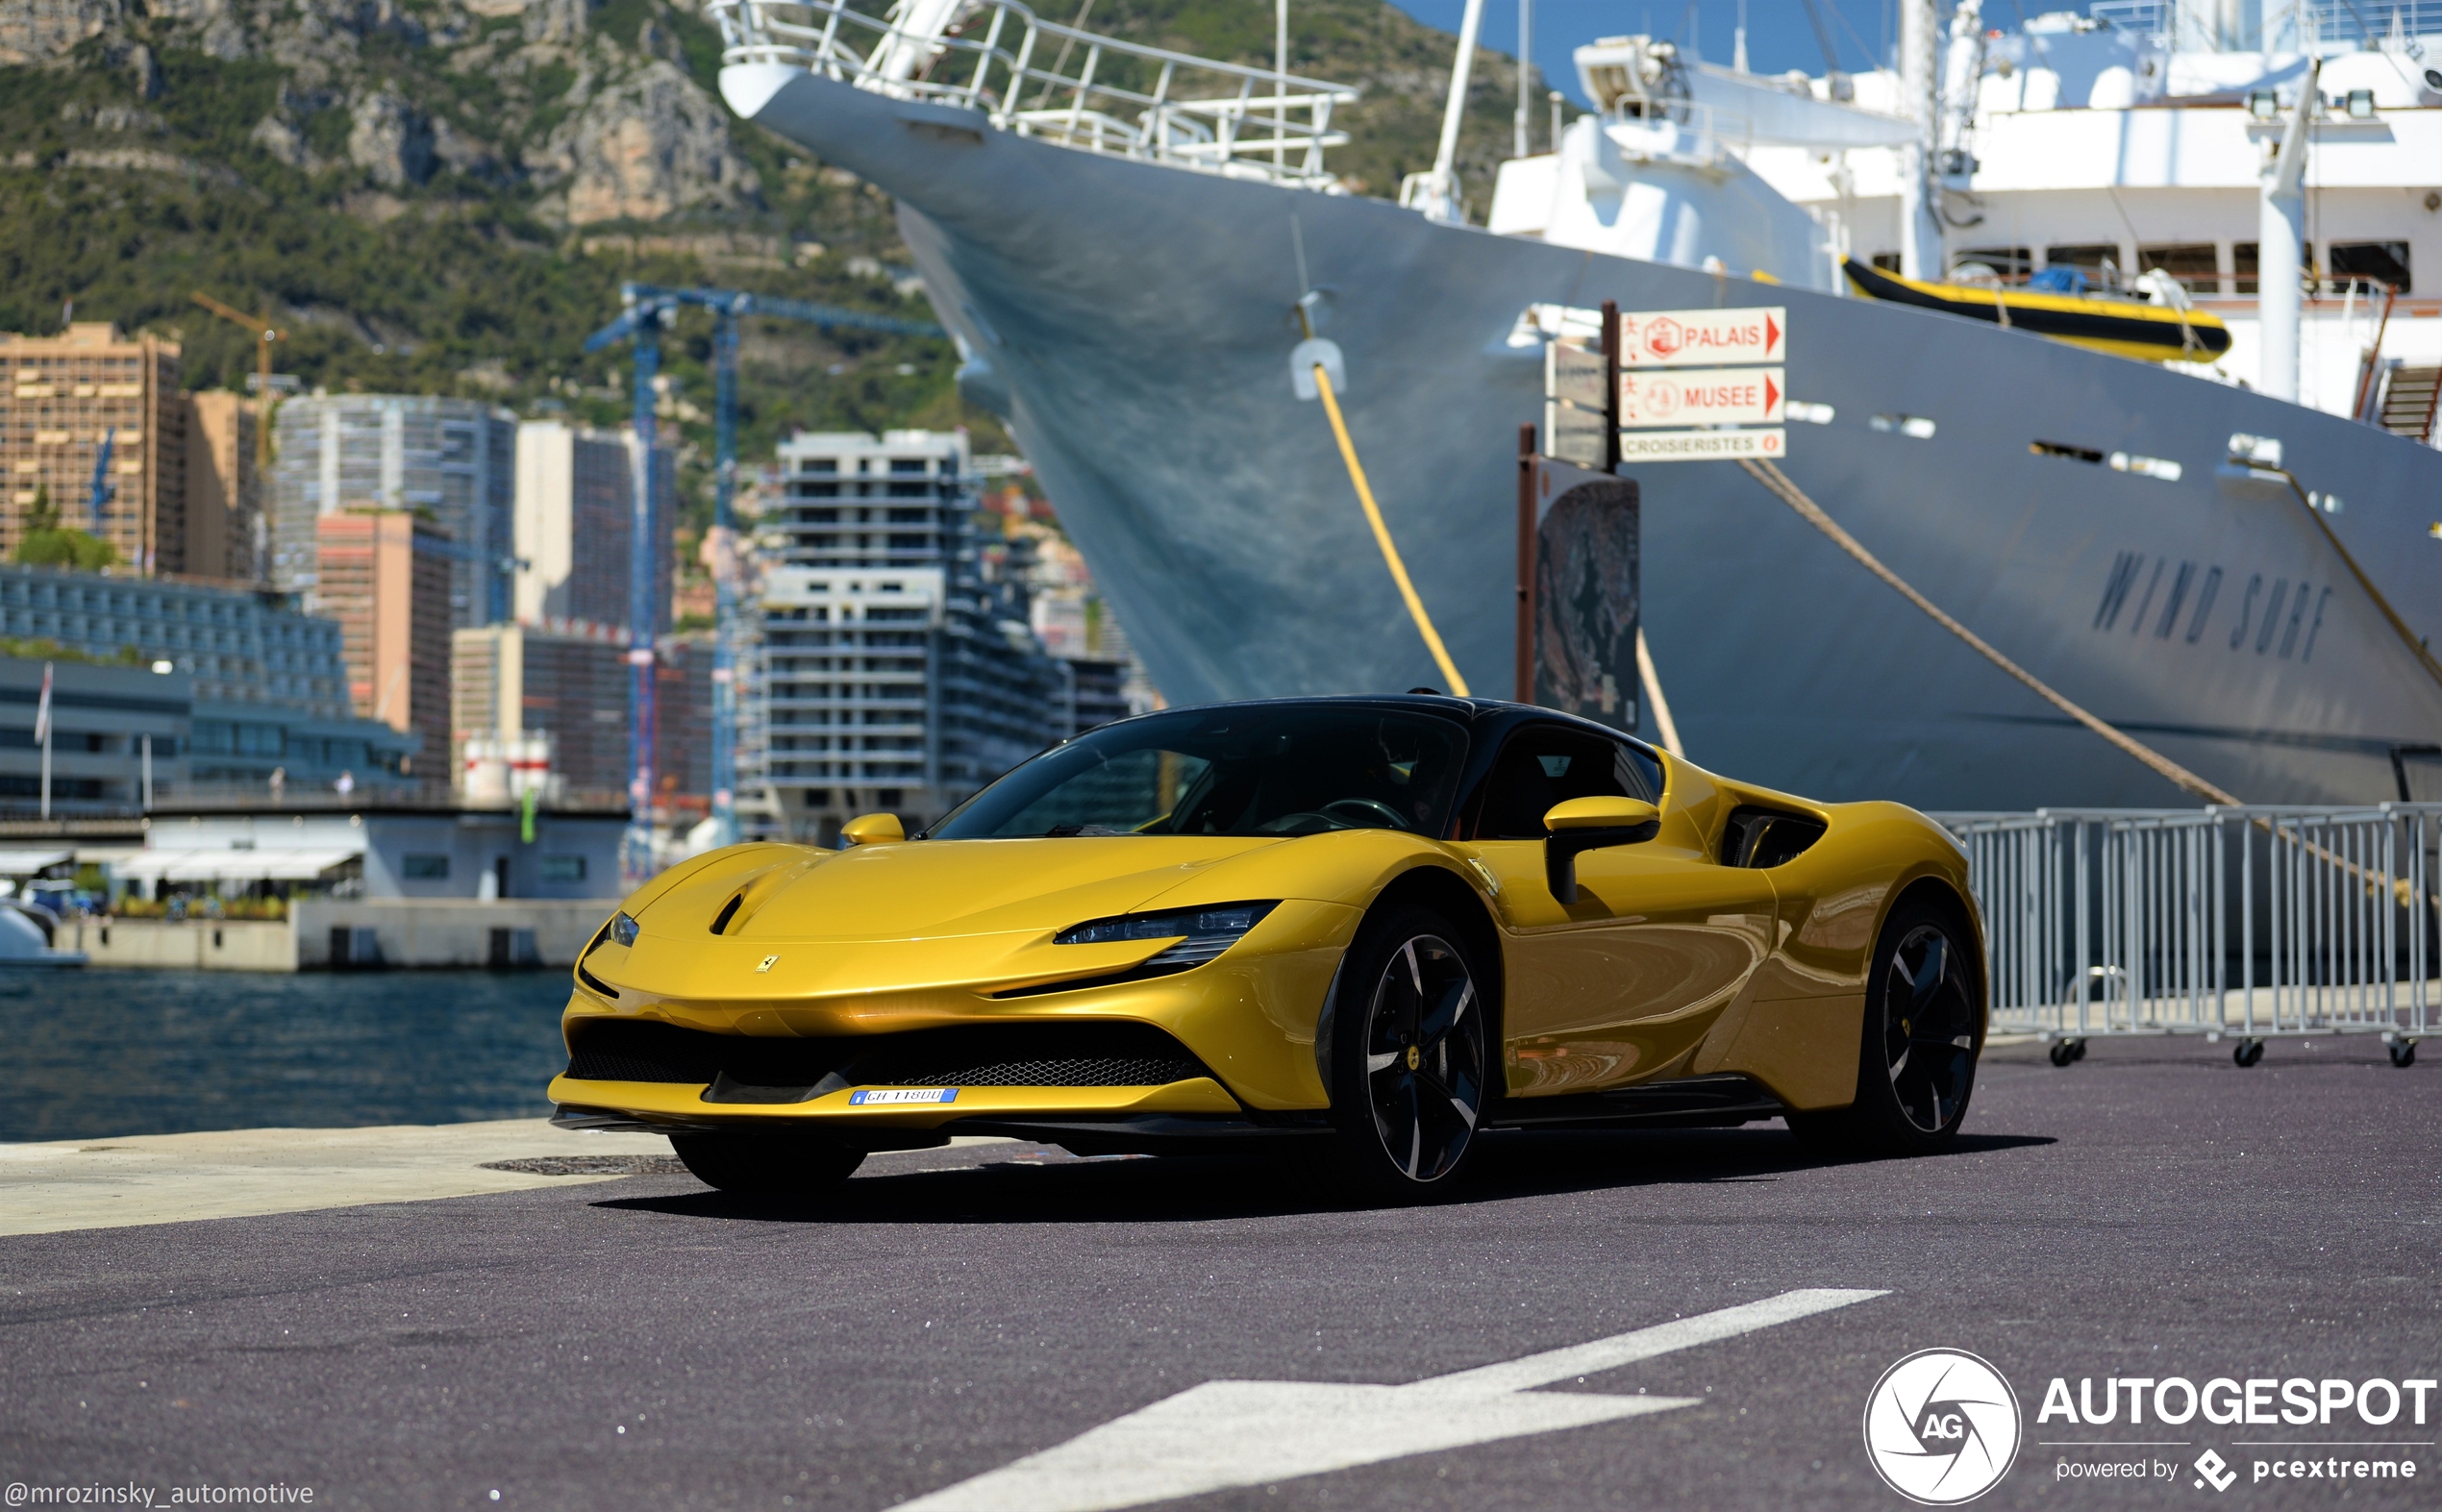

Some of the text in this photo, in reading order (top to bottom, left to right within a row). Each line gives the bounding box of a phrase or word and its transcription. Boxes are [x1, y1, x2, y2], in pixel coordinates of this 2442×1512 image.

[1685, 326, 1760, 348] PALAIS
[1684, 386, 1757, 408] MUSEE
[1626, 437, 1754, 454] CROISIERISTES
[2092, 550, 2332, 664] WIND SURF
